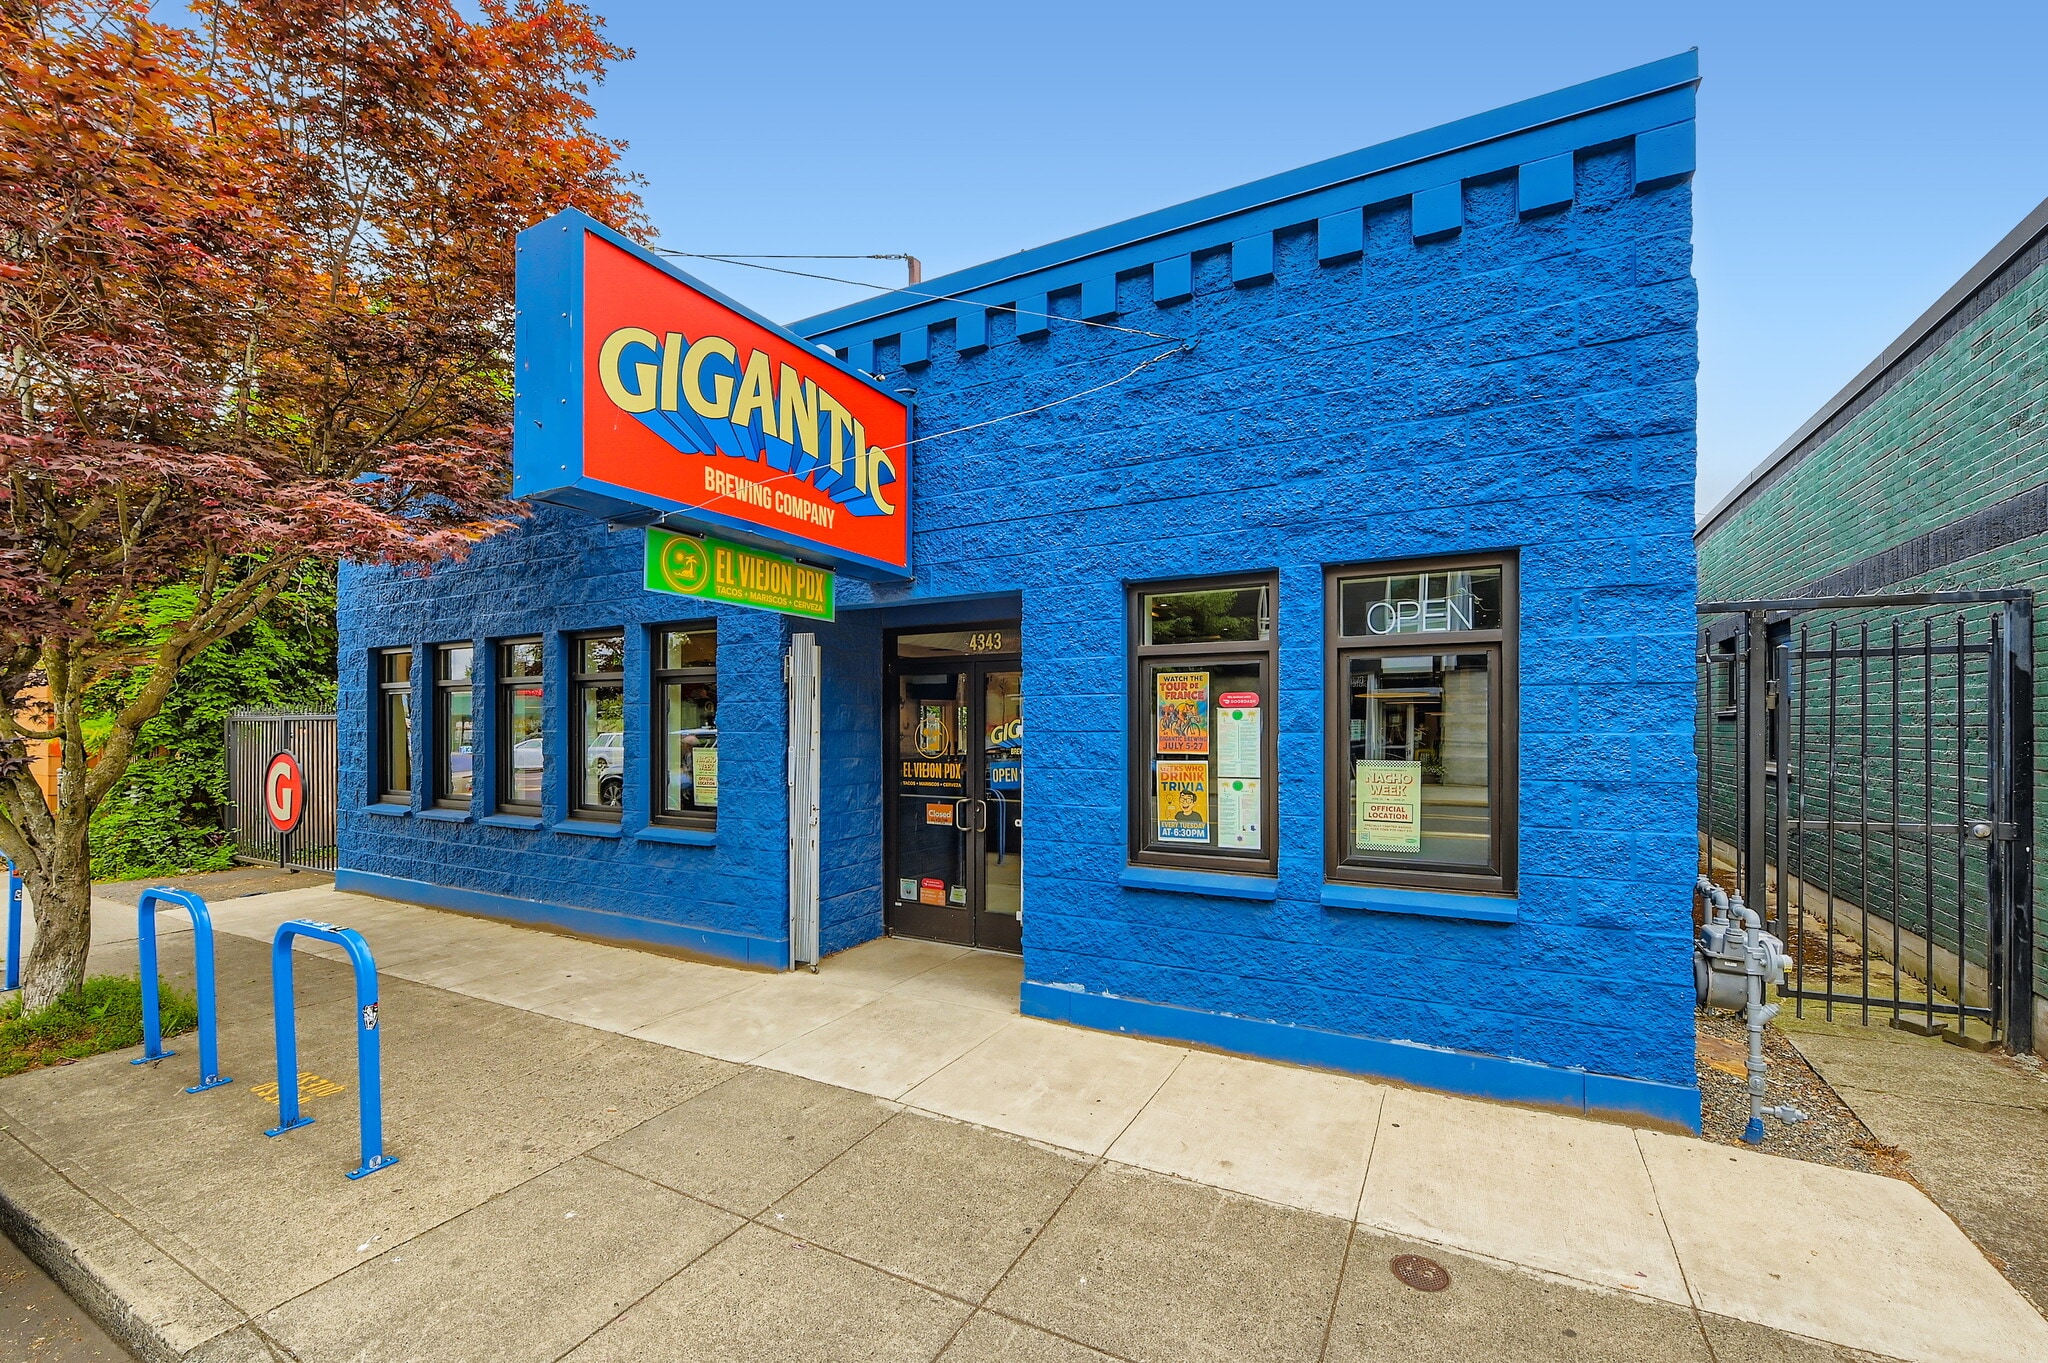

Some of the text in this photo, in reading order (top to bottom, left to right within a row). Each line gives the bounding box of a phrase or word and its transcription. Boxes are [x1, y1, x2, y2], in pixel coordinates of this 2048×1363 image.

[598, 326, 896, 516] GIGANTIC
[704, 466, 835, 529] BREWING COMPANY
[716, 549, 825, 603] EL VIEJON PDX
[716, 585, 743, 598] TACOS
[749, 591, 788, 606] MARISCOS
[793, 599, 823, 613] CERVEZA
[1367, 597, 1473, 635] OPEN
[970, 632, 1002, 651] 4343
[1160, 682, 1188, 691] TOUR
[1164, 691, 1205, 700] FRANCE
[1163, 742, 1203, 750] JULY 5-27
[903, 761, 912, 778] EL
[944, 763, 961, 779] PDX
[992, 767, 1018, 783] OPEN
[1365, 772, 1414, 785] NACHO
[268, 761, 292, 821] G
[1160, 782, 1205, 792] TRIVIA
[1370, 785, 1408, 797] WEEK
[928, 809, 952, 818] Closed
[1370, 805, 1406, 813] OFFICIAL
[1368, 812, 1408, 820] LOCATION
[1179, 821, 1206, 829] TUESDAY
[1173, 828, 1205, 838] 6:30PM
